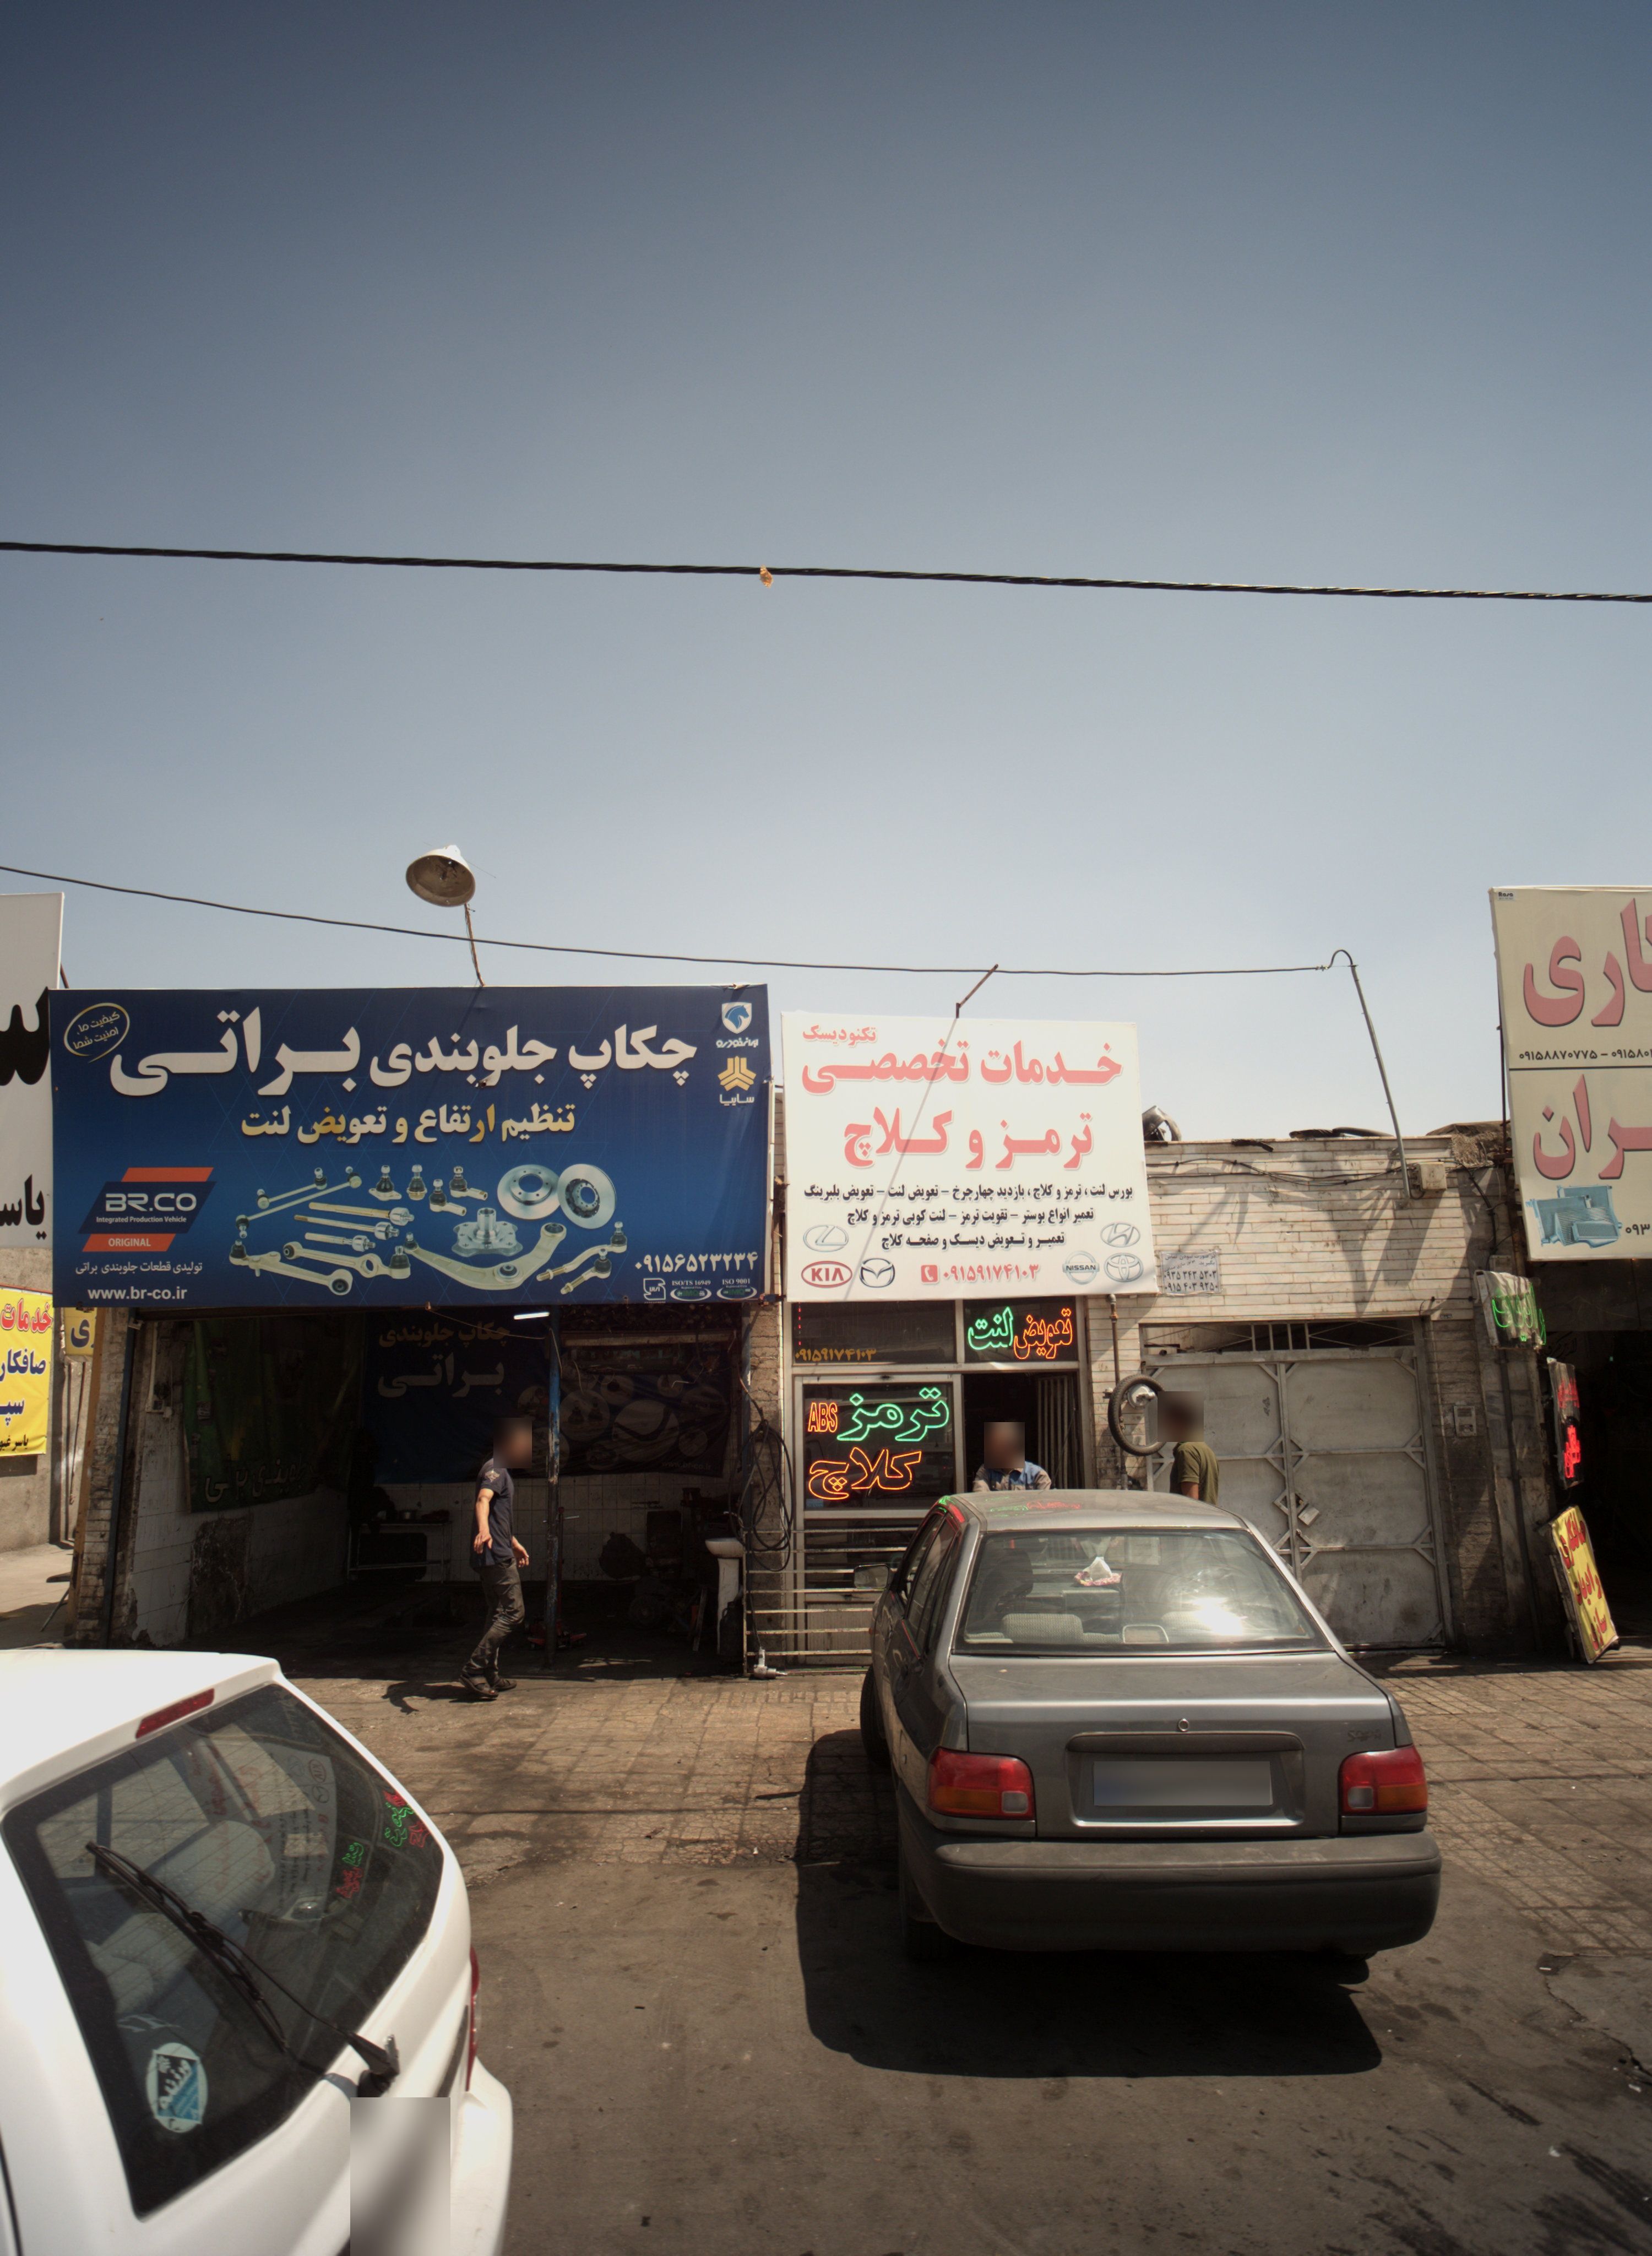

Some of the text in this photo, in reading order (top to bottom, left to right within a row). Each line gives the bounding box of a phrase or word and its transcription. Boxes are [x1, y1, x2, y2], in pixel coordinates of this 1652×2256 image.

[90, 1012, 119, 1028] کیفیت
[73, 1027, 118, 1049] امنیت شما
[110, 1007, 361, 1096] براتی
[370, 1024, 557, 1087] جلوبندی
[569, 1024, 697, 1089] چکاپ
[1611, 1049, 1652, 1059] ۰۹۱۵۸۰
[801, 1038, 1123, 1094] خدمات تخصصی
[242, 1103, 575, 1143] تنظیم ارتفاع و تعویض لنت
[844, 1107, 1094, 1170] ترمز و کلاچ
[804, 1184, 840, 1200] بلبرینگ
[843, 1185, 873, 1201] تعویض
[888, 1185, 905, 1197] لنت
[908, 1185, 938, 1201] تعویض
[997, 1185, 1024, 1200] بازدید
[1056, 1189, 1061, 1200] و
[1063, 1184, 1082, 1200] ترمز
[1108, 1185, 1133, 1200] بورس
[0, 1174, 46, 1240] یاس
[106, 1193, 197, 1211] BR.CO
[847, 1207, 1094, 1225] تعمیر انواع بوستر تقویت ترمز لنت کوبی ترمز و کلاچ
[1626, 1224, 1650, 1235] ۰۹۳
[108, 1238, 151, 1246] ORIGINAL
[882, 1232, 1064, 1249] تعمیر و تعویض دیسک و صفحه کلاچ
[75, 1261, 203, 1275] تولیدی قطعات جلوبندی براتی
[635, 1251, 758, 1273] ۰۹۱۵۶۵۲۳۲۳۴
[811, 1268, 844, 1282] KIA
[943, 1264, 1039, 1283] ۰۹۱۵۹۱۷۴۱۰۳
[88, 1286, 187, 1299] www.br-co.ir
[1, 1298, 53, 1333] خدمات
[379, 1321, 511, 1348] چکاپ جلوبندی
[967, 1306, 1014, 1351] لنت
[795, 1348, 877, 1362] ۰۹۱۵۹۱۷۴۱۰۳
[0, 1349, 46, 1381] صافکار
[378, 1352, 505, 1398] براتی
[808, 1402, 838, 1433] ABS
[836, 1387, 950, 1441] ترمز
[808, 1446, 922, 1500] کلاچ
